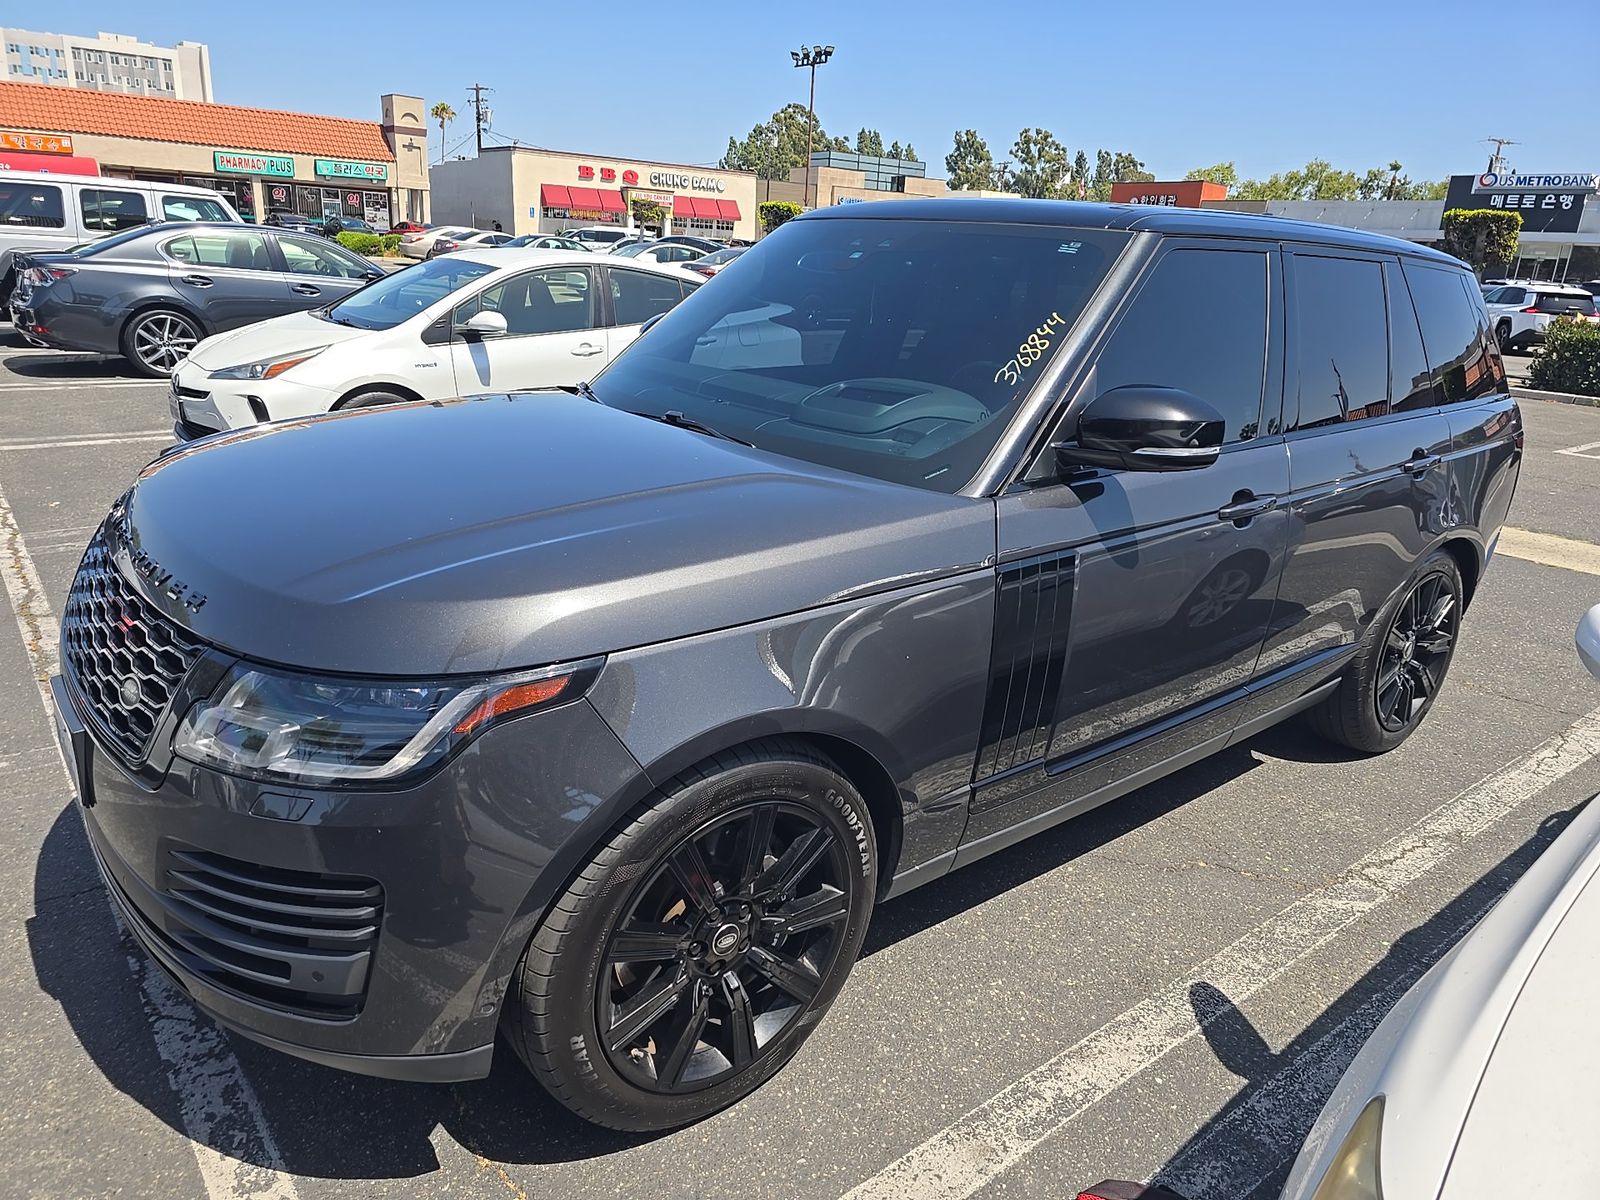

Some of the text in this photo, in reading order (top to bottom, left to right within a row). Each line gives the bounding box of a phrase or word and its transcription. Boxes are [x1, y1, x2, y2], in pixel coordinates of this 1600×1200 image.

[219, 155, 292, 173] PHARMACY PLUS
[650, 172, 689, 189] CHUNG
[1490, 194, 1574, 210] 메트로 은행
[824, 788, 872, 878] GOODYEAR
